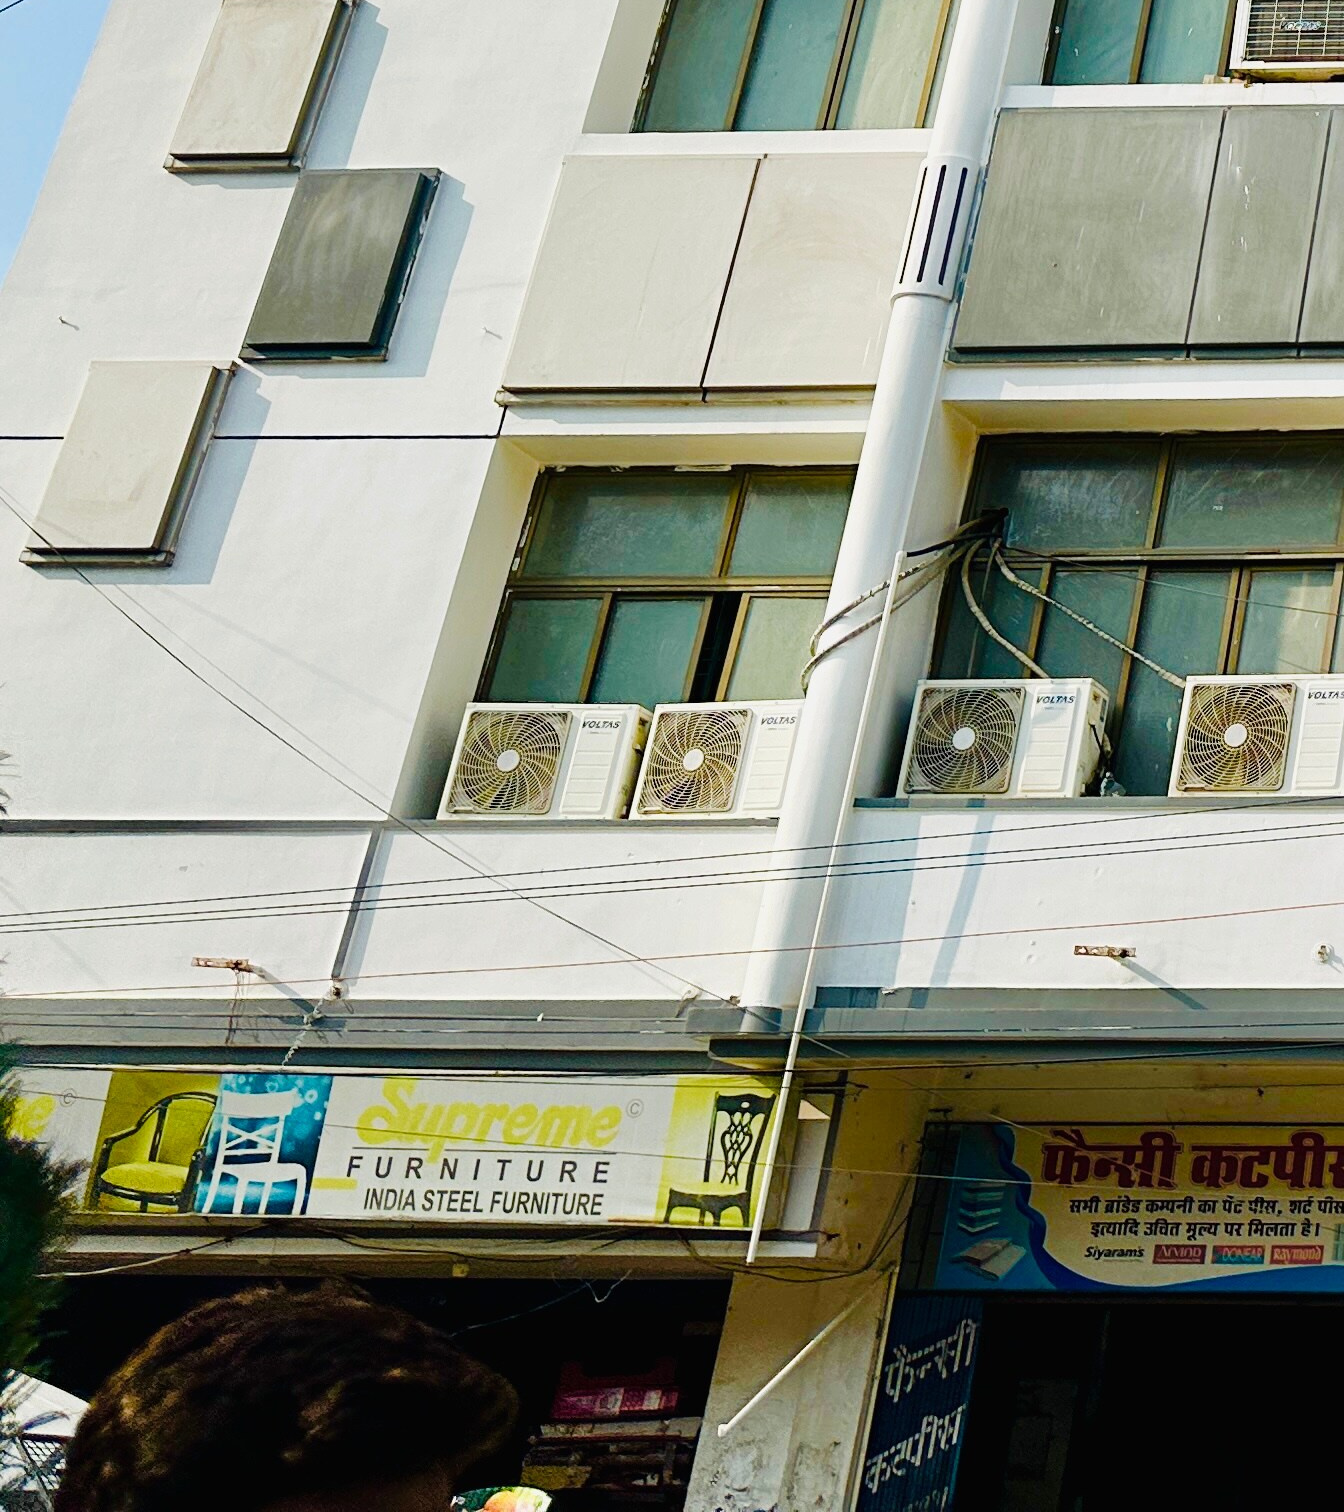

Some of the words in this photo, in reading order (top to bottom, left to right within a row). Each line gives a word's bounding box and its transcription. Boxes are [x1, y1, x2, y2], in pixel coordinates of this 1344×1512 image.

[1035, 694, 1076, 705] VOLTAS
[582, 719, 621, 729] VOLTAS
[760, 716, 798, 726] VOLTAS
[357, 1077, 622, 1163] Supreme
[1042, 1129, 1183, 1189] फैन्सी
[346, 1156, 610, 1183] FURNITURE
[364, 1187, 416, 1211] INDIA
[422, 1189, 483, 1213] STEEL
[490, 1191, 603, 1215] FURNITURE
[1069, 1196, 1101, 1214] सभी
[1197, 1199, 1218, 1214] का
[1143, 1218, 1181, 1236] उचित
[1224, 1222, 1243, 1236] पर
[1248, 1218, 1296, 1236] मिलता
